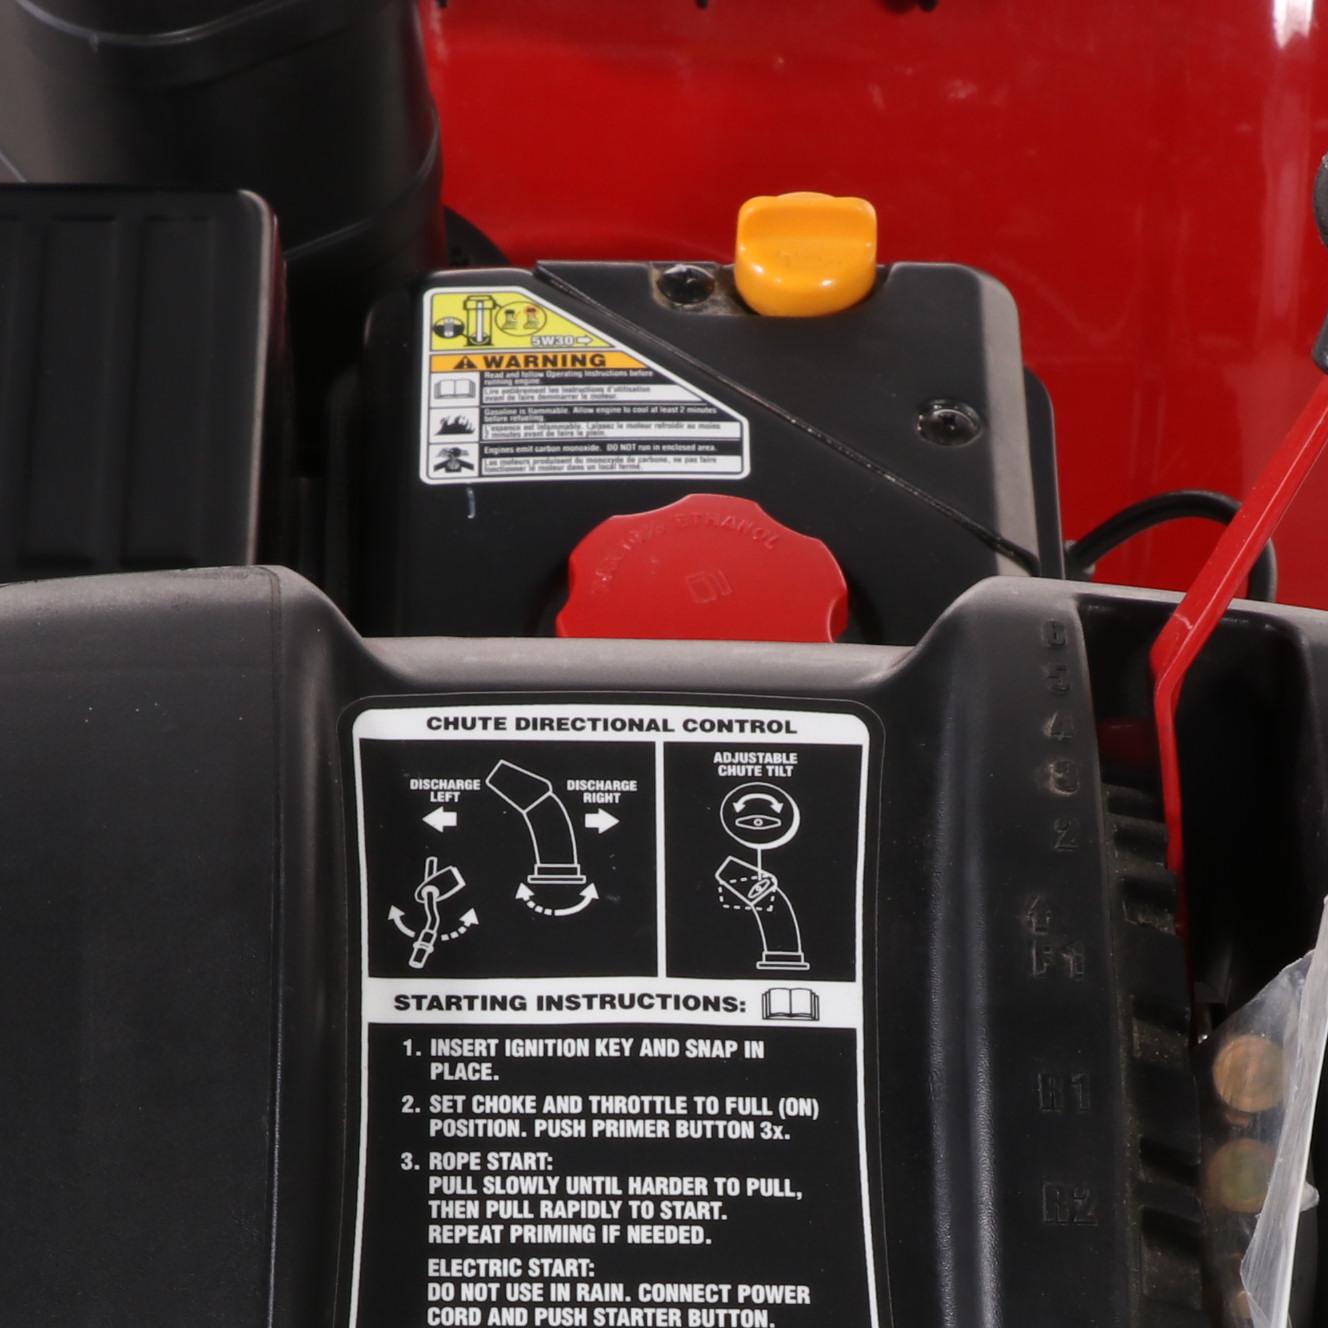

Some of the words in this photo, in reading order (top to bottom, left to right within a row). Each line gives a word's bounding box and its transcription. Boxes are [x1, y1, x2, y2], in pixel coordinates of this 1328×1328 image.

[531, 335, 573, 346] 5W30
[484, 354, 606, 369] WARNING
[427, 717, 507, 730] CHUTE
[516, 717, 675, 732] DIRECTIONAL
[683, 719, 797, 734] CONTROL
[1043, 711, 1074, 741] 4
[714, 752, 797, 764] ADJUSTABLE
[718, 765, 760, 776] CHUTE
[766, 765, 793, 776] TILT
[410, 779, 480, 790] DISCHARGE
[567, 780, 637, 791] DISCHARGE
[430, 791, 460, 802] LEFT
[584, 792, 621, 803] RIGHT
[1052, 817, 1080, 852] 2
[394, 994, 526, 1011] STARTING
[537, 993, 745, 1012] INSTRUCTIONS:
[403, 1039, 421, 1056] 1.
[431, 1039, 499, 1056] INSERT
[506, 1039, 589, 1057] IGNITION
[596, 1038, 633, 1056] KEY
[640, 1039, 679, 1057] AND
[686, 1039, 737, 1057] SNAP
[745, 1041, 763, 1058] IN
[431, 1062, 499, 1080] PLACE.
[402, 1095, 420, 1113] 2.
[430, 1095, 466, 1113] SET
[473, 1095, 536, 1113] CHOKE
[543, 1096, 582, 1113] AND
[589, 1095, 687, 1114] THROTTLE
[694, 1096, 719, 1114] TO
[726, 1097, 773, 1115] FULL
[779, 1097, 818, 1120] (ON)
[430, 1119, 526, 1137] POSITION.
[535, 1119, 585, 1137] PUSH
[593, 1120, 669, 1137] PRIMER
[676, 1120, 754, 1138] BUTTON
[760, 1121, 790, 1139] 3x.
[401, 1152, 419, 1170] 3.
[430, 1152, 481, 1170] ROPE
[487, 1152, 552, 1170] START:
[429, 1176, 477, 1194] PULL
[483, 1176, 559, 1194] SLOWLY
[566, 1176, 622, 1195] UNTIL
[629, 1177, 708, 1195] HARDER
[714, 1177, 740, 1196] TO
[747, 1178, 802, 1200] PULL,
[429, 1200, 479, 1218] THEN
[486, 1200, 534, 1219] PULL
[540, 1200, 622, 1218] RAPIDLY
[629, 1200, 654, 1219] TO
[660, 1201, 727, 1219] START.
[429, 1225, 504, 1243] REPEAT
[511, 1224, 595, 1243] PRIMING
[602, 1225, 620, 1243] IF
[628, 1225, 711, 1244] NEEDED.
[429, 1258, 522, 1277] ELECTRIC
[528, 1258, 594, 1277] START:
[428, 1283, 454, 1301] DO
[461, 1283, 500, 1301] NOT
[506, 1283, 543, 1301] USE
[551, 1283, 570, 1301] IN
[577, 1283, 631, 1301] RAIN.
[639, 1283, 731, 1303] CONNECT
[738, 1285, 810, 1304] POWER
[428, 1307, 481, 1326] CORD
[488, 1308, 527, 1326] AND
[535, 1308, 587, 1326] PUSH
[593, 1308, 681, 1327] STARTER
[688, 1309, 775, 1328] BUTTON.
